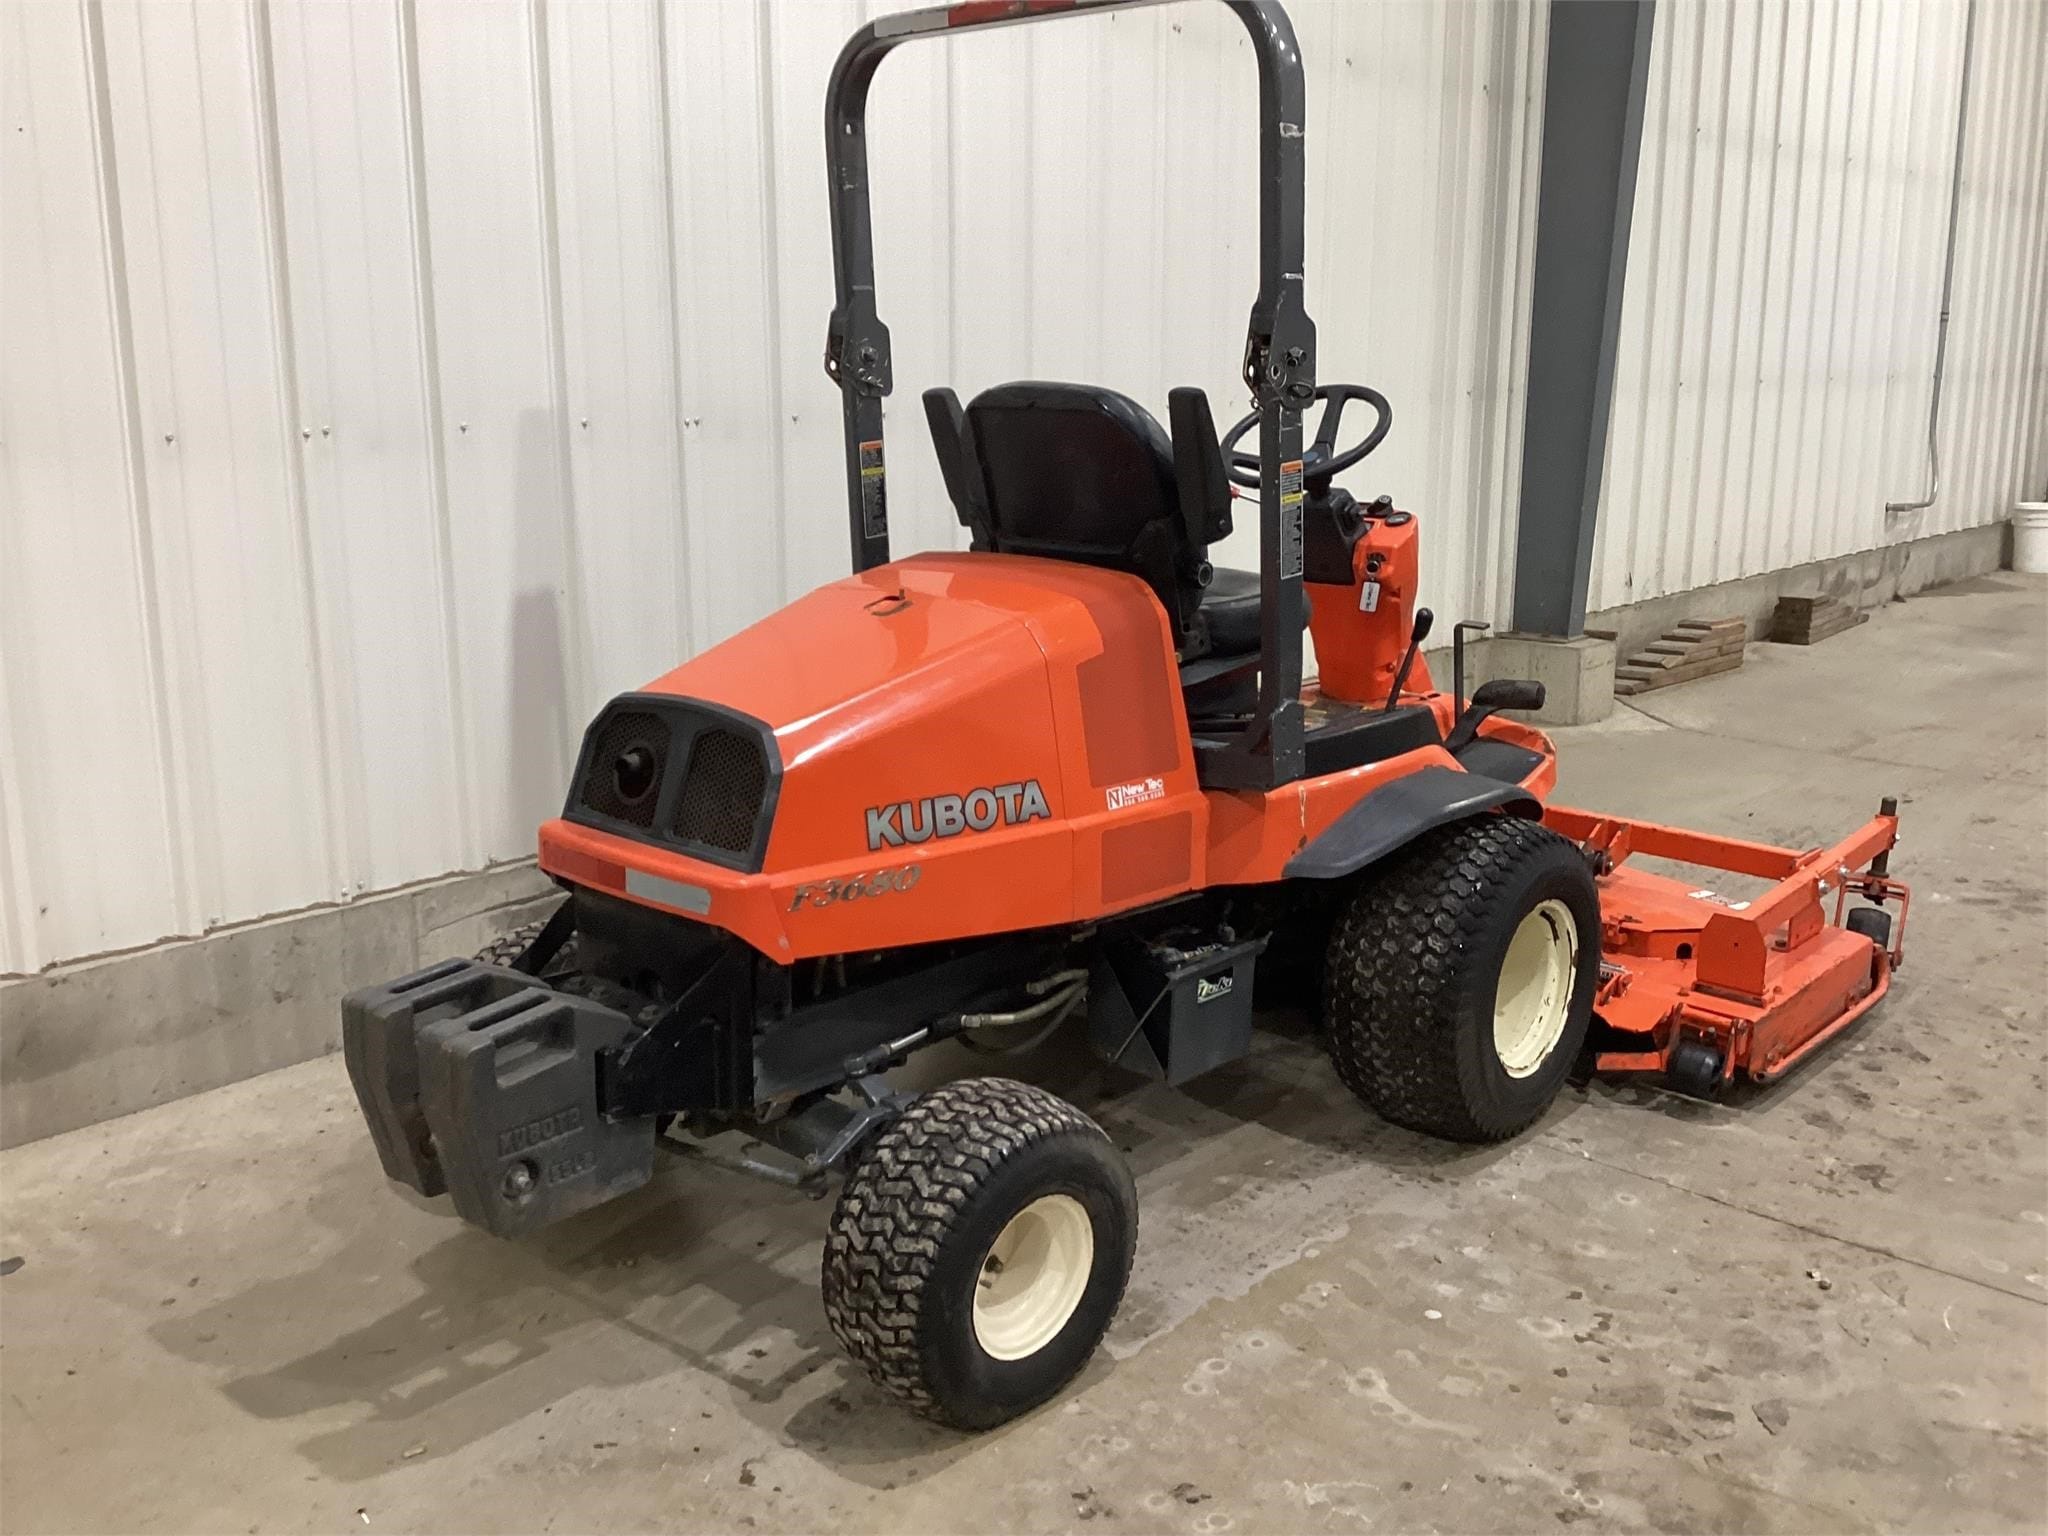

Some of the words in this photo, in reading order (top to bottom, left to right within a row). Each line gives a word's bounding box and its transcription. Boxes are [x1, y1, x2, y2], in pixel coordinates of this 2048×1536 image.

[1122, 783, 1145, 796] New
[1145, 778, 1163, 790] Tec
[865, 779, 1051, 851] KUBOTA
[787, 864, 922, 912] F3680
[498, 1106, 580, 1157] KUBOTA
